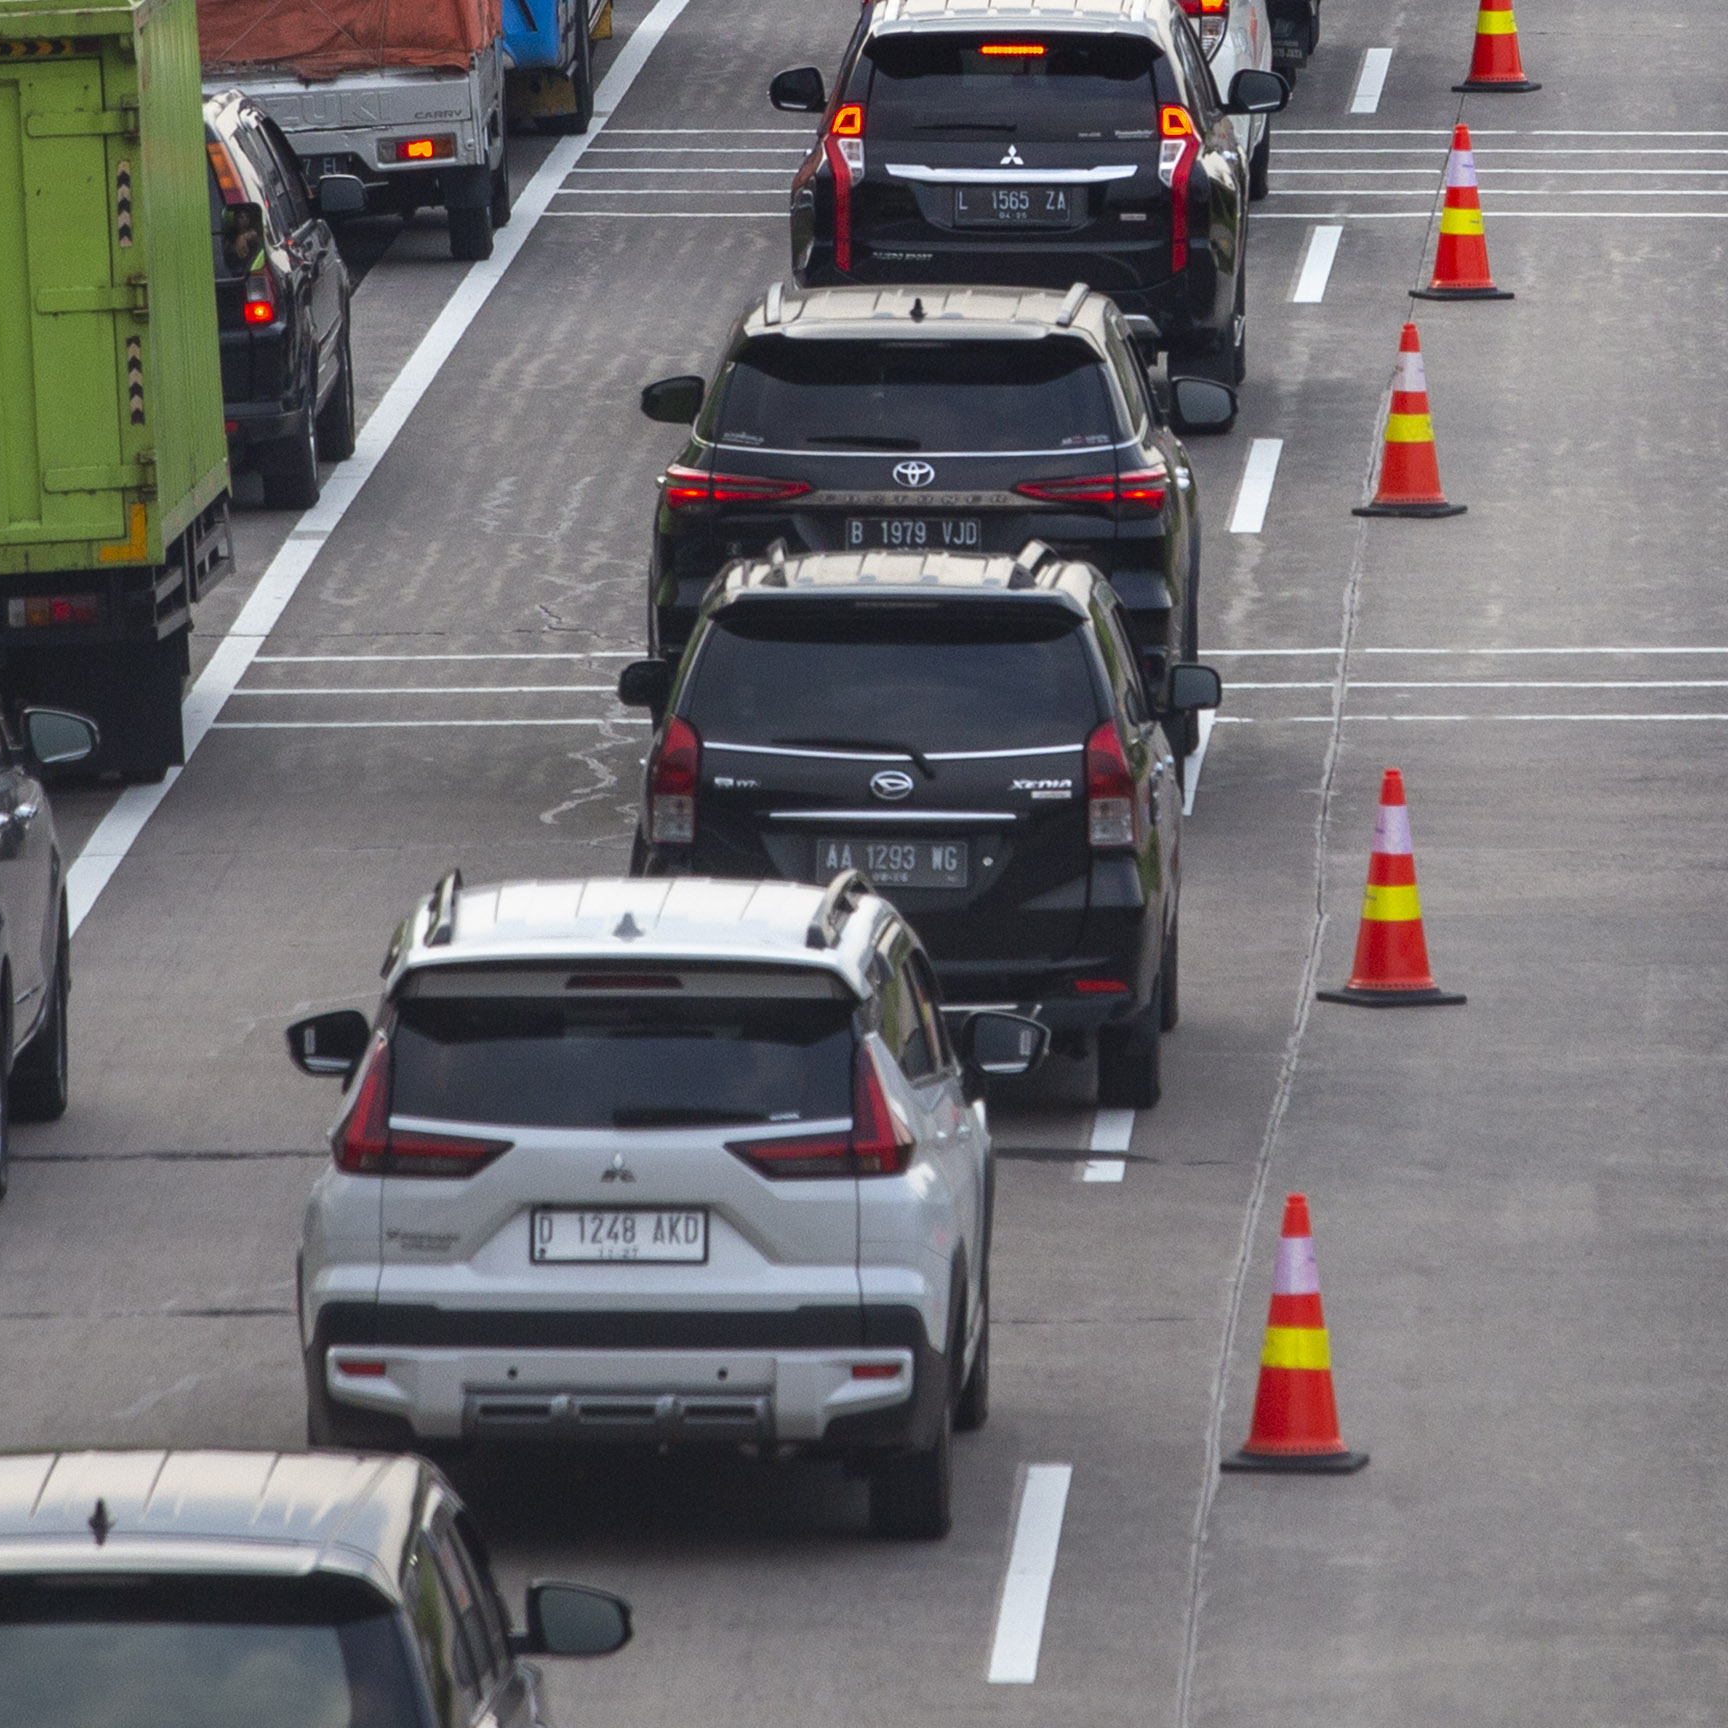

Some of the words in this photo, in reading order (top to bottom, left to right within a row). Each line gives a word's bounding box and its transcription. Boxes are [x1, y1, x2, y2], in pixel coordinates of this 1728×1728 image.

[252, 91, 393, 122] ZUKI
[414, 109, 463, 120] CARRY
[958, 191, 968, 210] L
[992, 191, 1030, 210] 1565
[1045, 191, 1066, 210] ZA
[850, 521, 863, 545] B
[880, 521, 927, 545] 1979
[942, 521, 978, 545] VJD
[826, 845, 853, 870] AA
[866, 846, 915, 871] 1293
[932, 846, 958, 871] WG
[539, 1215, 553, 1245] D
[577, 1215, 636, 1245] 1248
[652, 1215, 699, 1245] AKD
